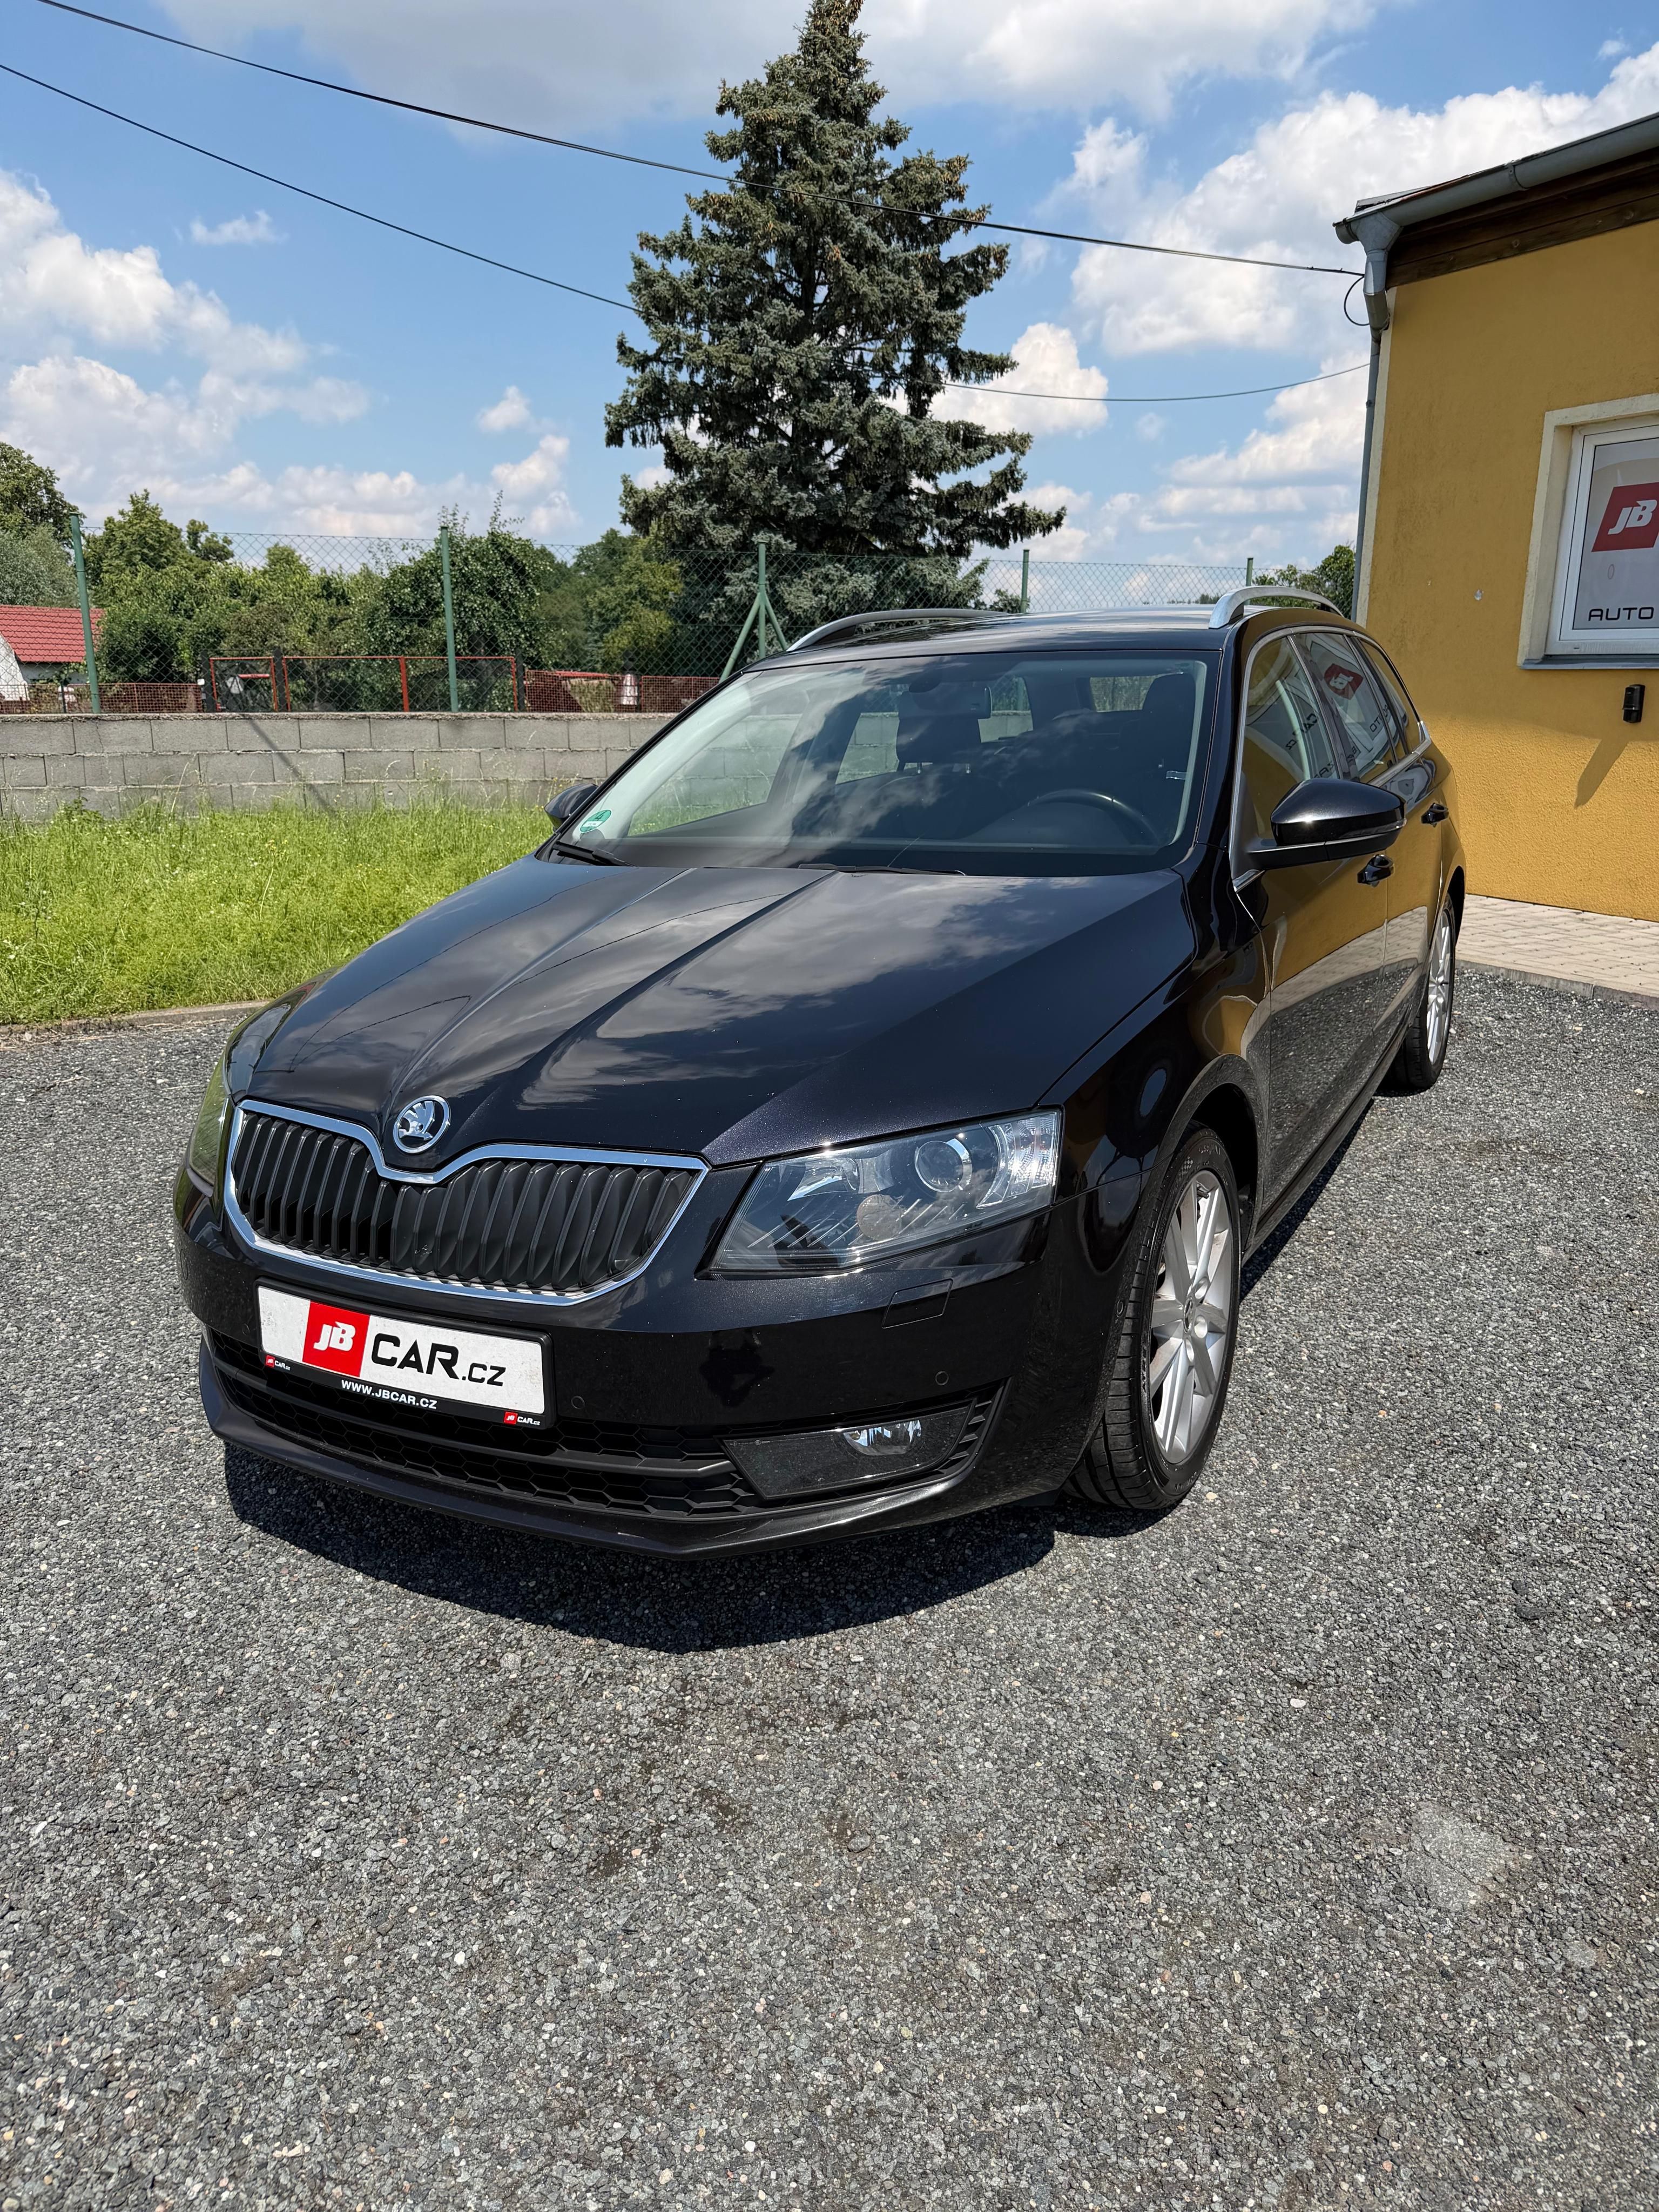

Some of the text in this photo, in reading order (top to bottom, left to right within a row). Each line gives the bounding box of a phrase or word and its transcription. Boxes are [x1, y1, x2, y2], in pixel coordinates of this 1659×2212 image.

[1607, 500, 1657, 535] JB
[1588, 606, 1654, 621] AUTO
[313, 1321, 356, 1352] JB
[341, 1379, 437, 1410] WWW.JBCAR.CZ
